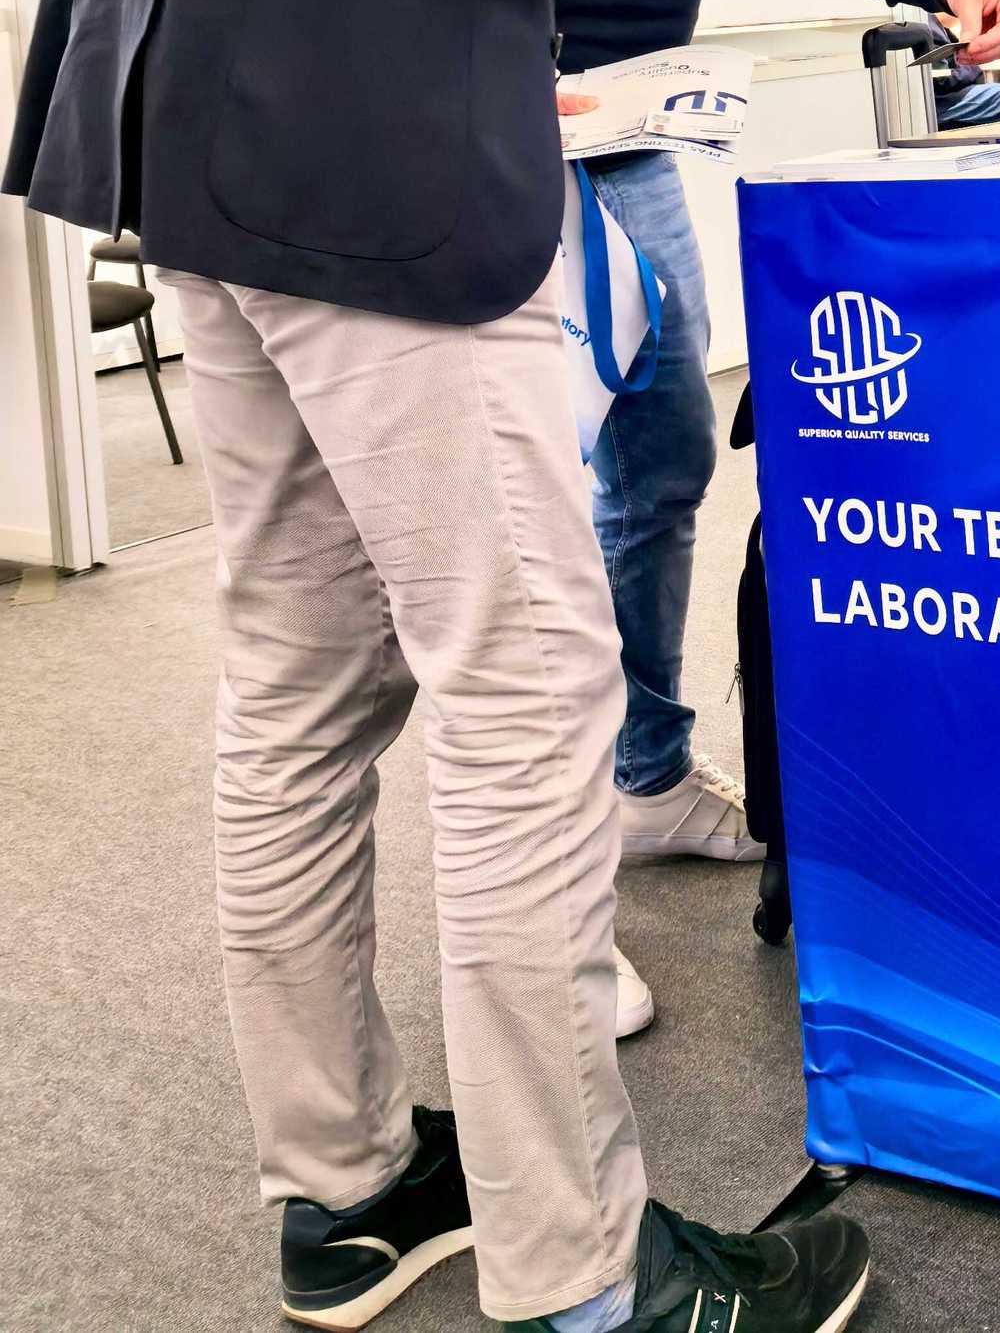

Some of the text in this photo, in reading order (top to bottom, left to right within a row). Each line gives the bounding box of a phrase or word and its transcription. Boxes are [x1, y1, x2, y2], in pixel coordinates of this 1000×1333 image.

[798, 428, 930, 443] SUPERIOR QUALITY SERVICES
[803, 497, 941, 554] YOUR
